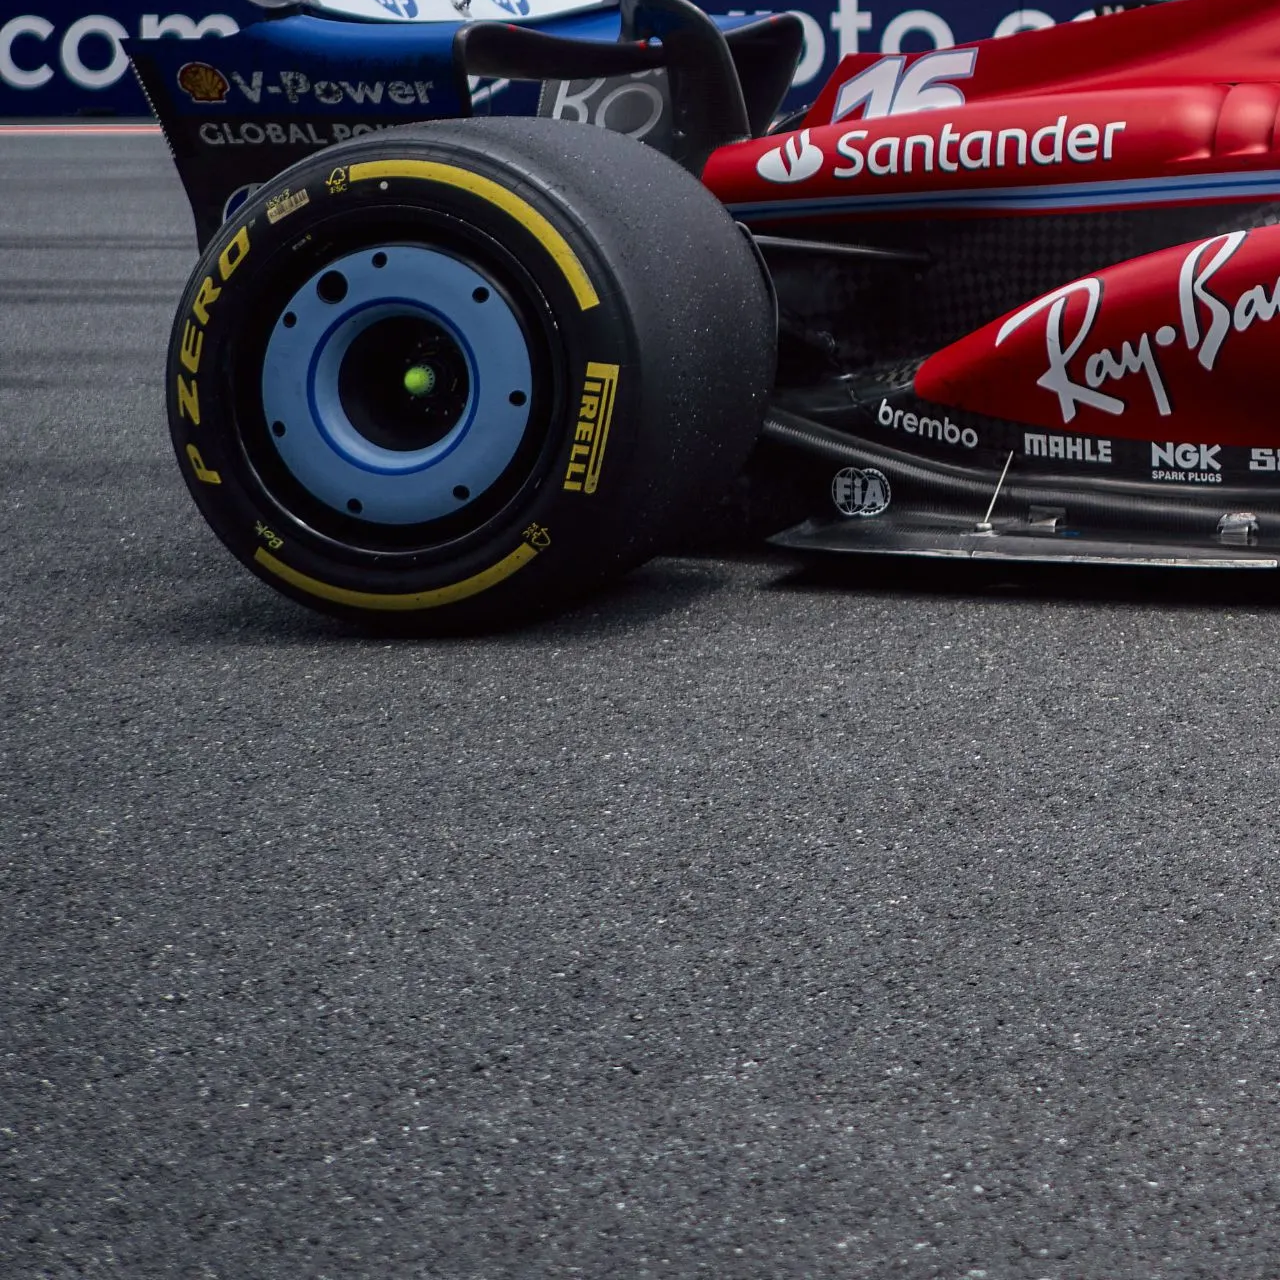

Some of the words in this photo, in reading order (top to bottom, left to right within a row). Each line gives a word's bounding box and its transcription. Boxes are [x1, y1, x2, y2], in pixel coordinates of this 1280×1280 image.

[231, 71, 434, 104] V-Power
[831, 46, 978, 124] 16
[199, 122, 329, 145] GLOBAL
[834, 116, 1126, 178] Santander
[177, 225, 250, 425] ZERO
[564, 362, 620, 494] PIRELLI
[877, 398, 979, 449] brembo
[186, 443, 222, 485] P
[1025, 433, 1112, 463] MAHLE
[1151, 442, 1222, 471] NGK
[1151, 470, 1185, 481] SPARK
[1188, 471, 1222, 483] PLUGS
